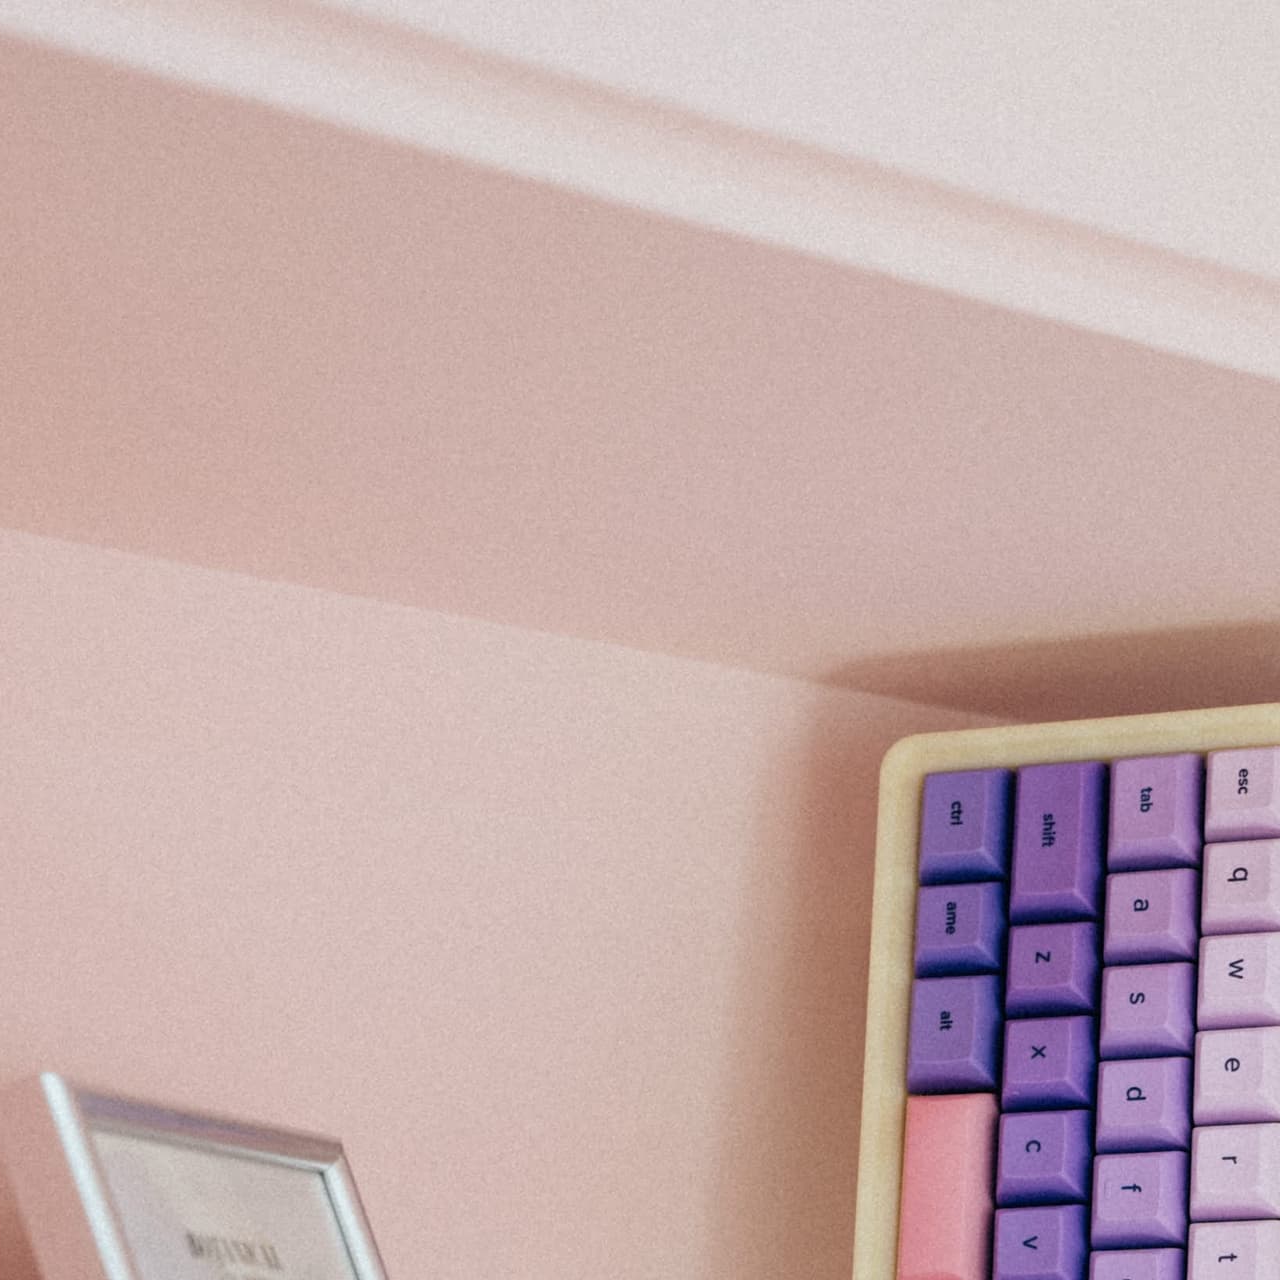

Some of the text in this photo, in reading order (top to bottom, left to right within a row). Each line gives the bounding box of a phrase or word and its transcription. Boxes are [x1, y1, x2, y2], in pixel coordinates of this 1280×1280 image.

[1238, 769, 1248, 794] esc
[1140, 787, 1153, 812] tab
[951, 801, 963, 825] ctrl
[1042, 814, 1056, 847] shift
[1227, 866, 1249, 883] q
[1133, 898, 1150, 913] a
[1034, 951, 1052, 964] z
[1228, 958, 1244, 980] w
[1128, 991, 1146, 1005] s
[940, 1011, 953, 1030] alt
[1030, 1045, 1047, 1060] x
[1224, 1057, 1241, 1073] e
[1125, 1086, 1147, 1102] d
[1024, 1139, 1042, 1153] c
[1221, 1155, 1238, 1165] r
[1120, 1183, 1143, 1193] f
[1022, 1235, 1038, 1251] v
[1217, 1252, 1238, 1263] t
